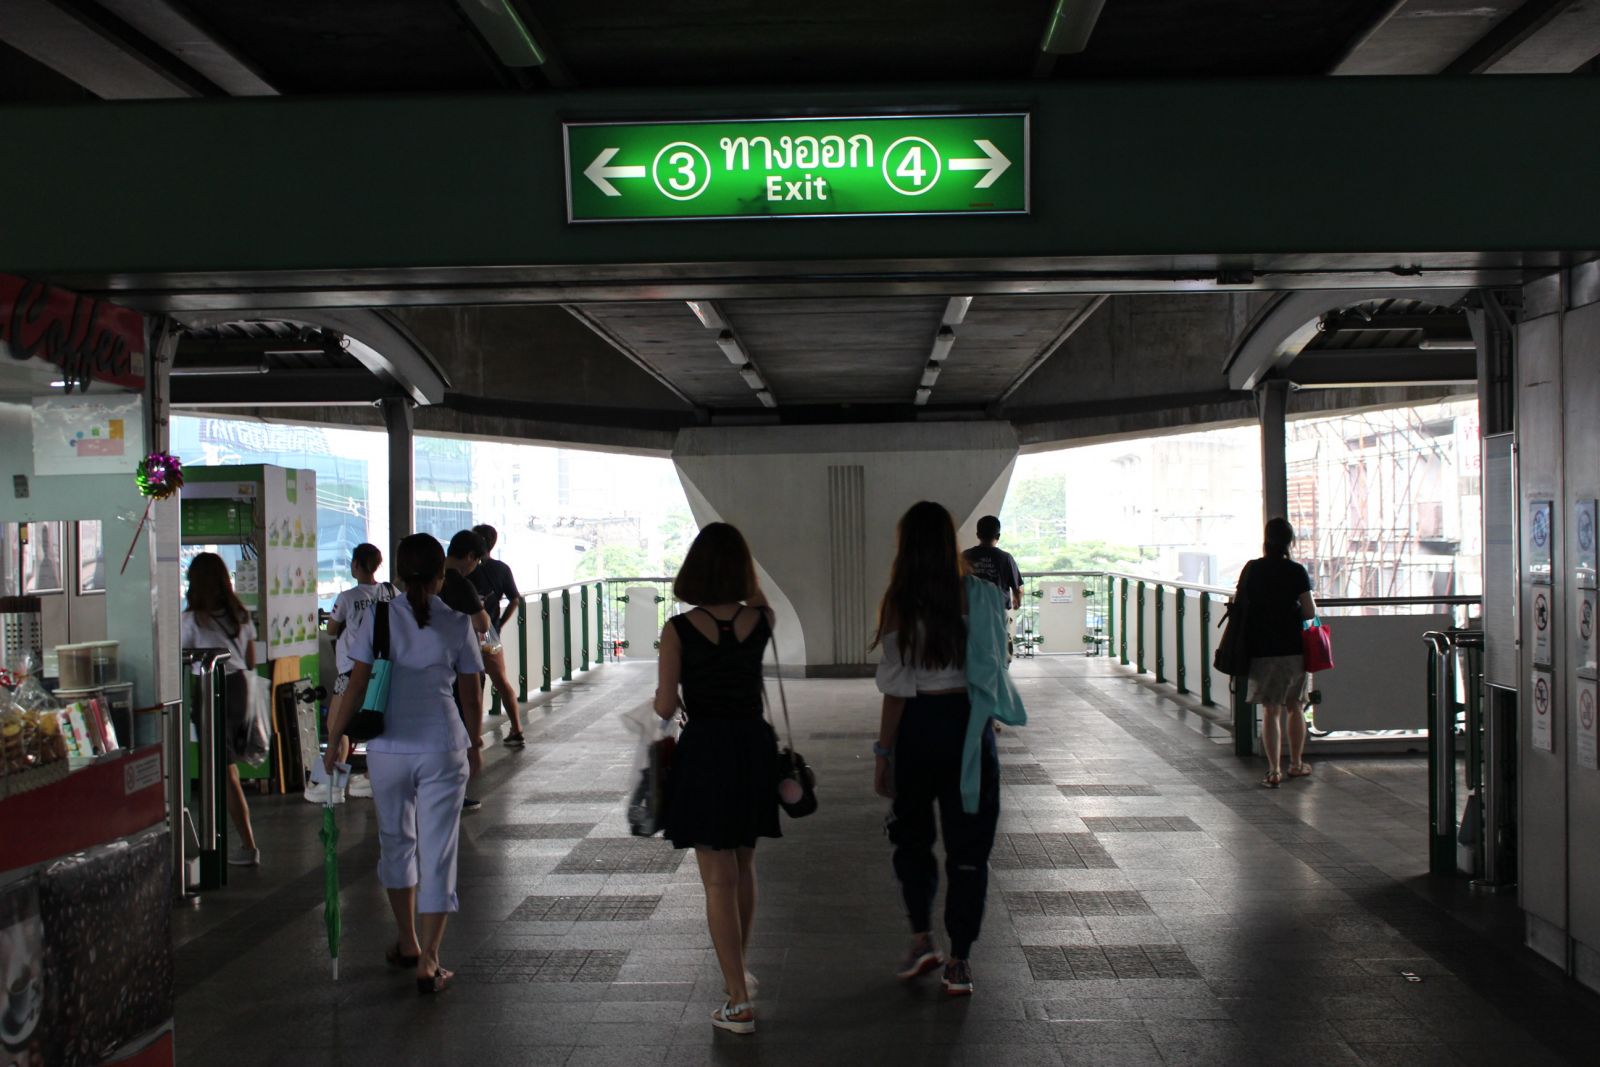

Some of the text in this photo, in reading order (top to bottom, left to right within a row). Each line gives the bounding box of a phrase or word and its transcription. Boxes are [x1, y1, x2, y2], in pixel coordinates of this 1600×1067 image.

[669, 152, 696, 190] 3
[720, 134, 874, 170] ทางออก
[896, 146, 927, 186] 4
[766, 173, 827, 201] Exit
[8, 277, 128, 394] Coffee
